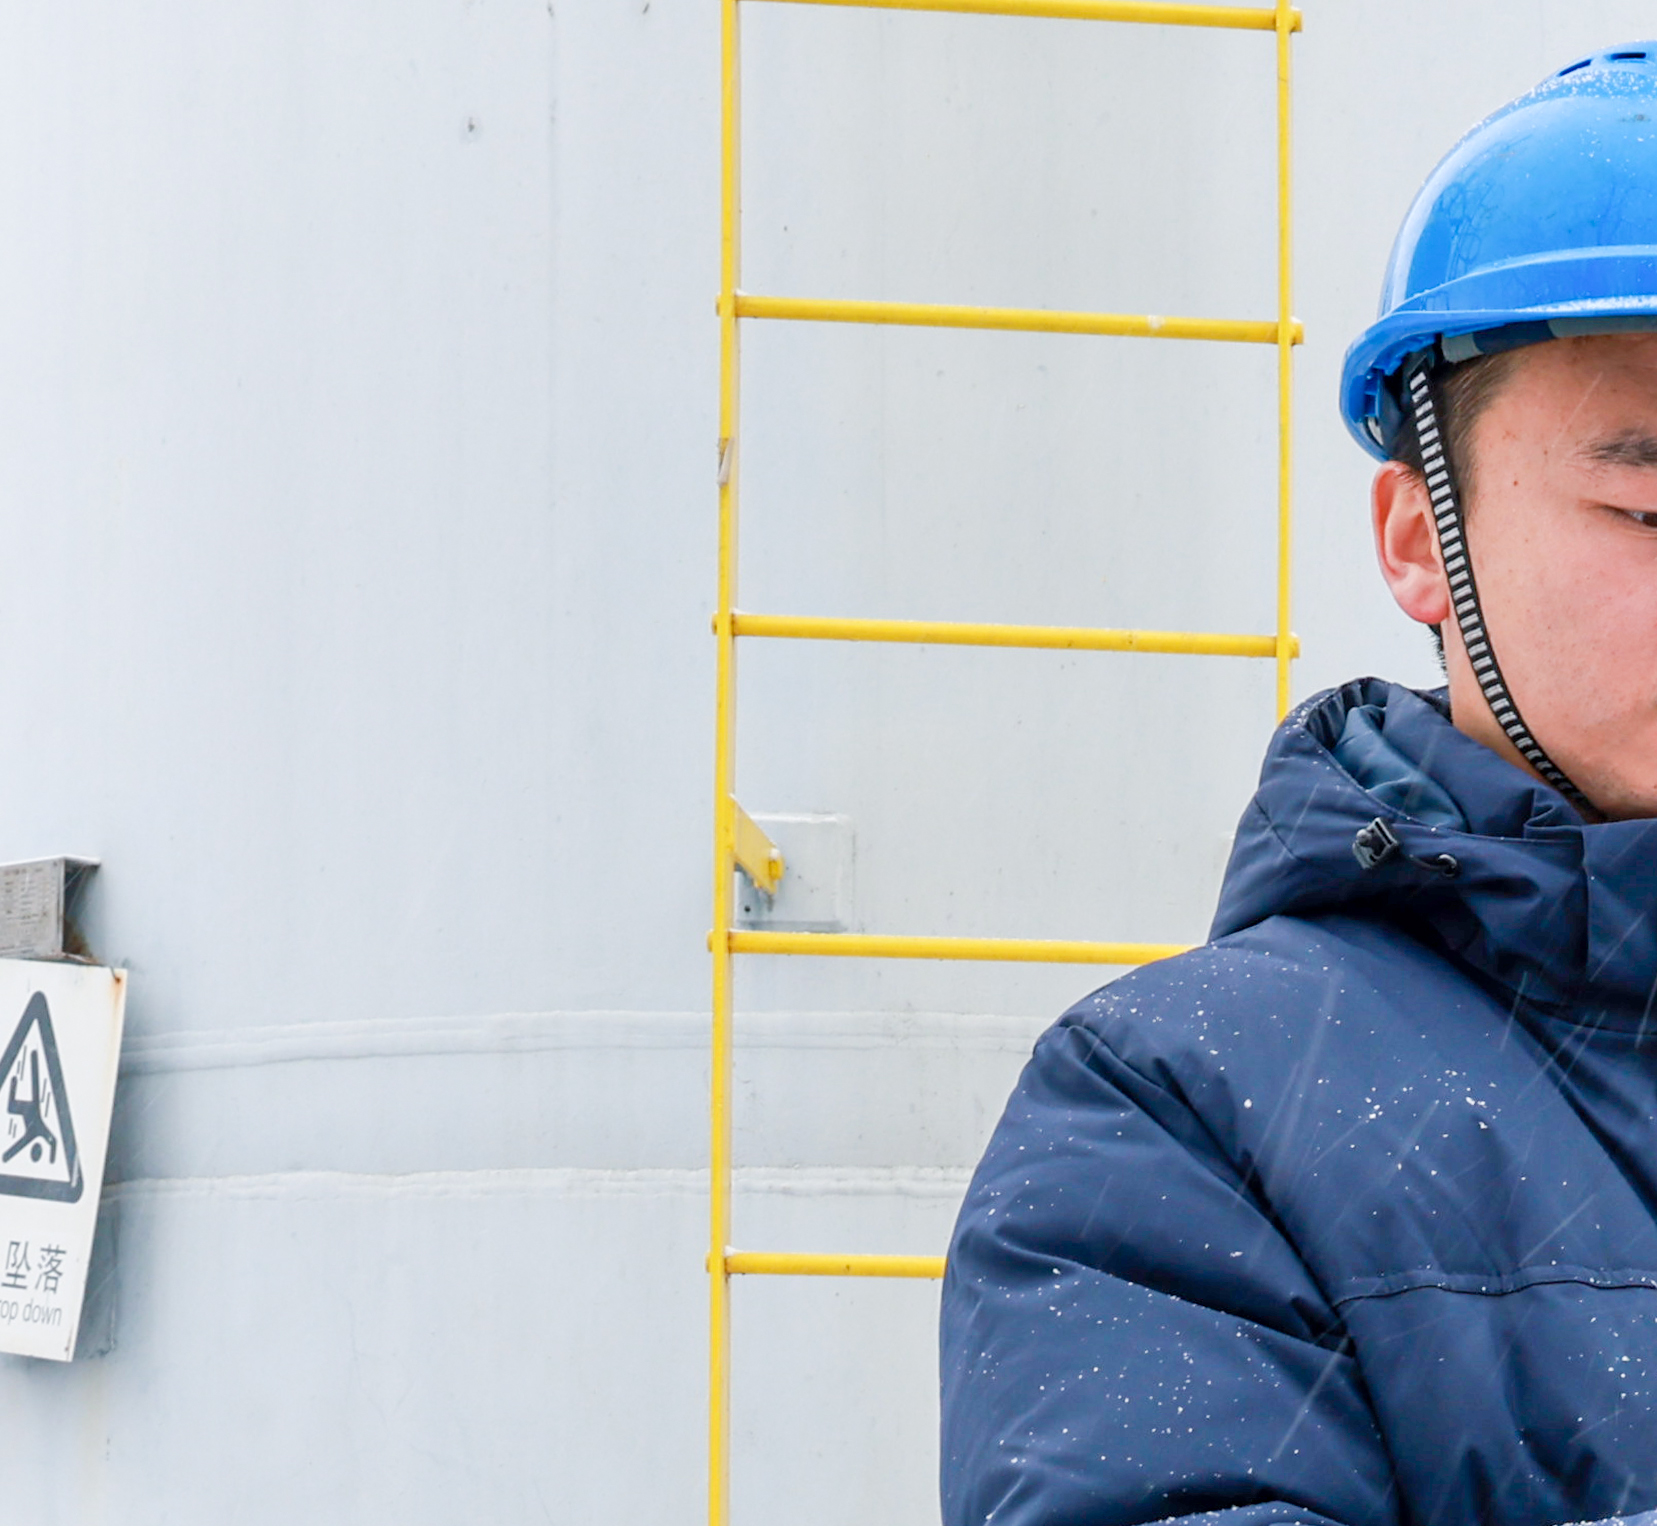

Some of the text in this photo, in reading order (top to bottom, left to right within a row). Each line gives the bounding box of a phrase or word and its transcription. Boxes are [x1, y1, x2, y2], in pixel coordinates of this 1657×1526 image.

[1, 1240, 68, 1294] 坠落
[0, 1298, 63, 1326] op down
